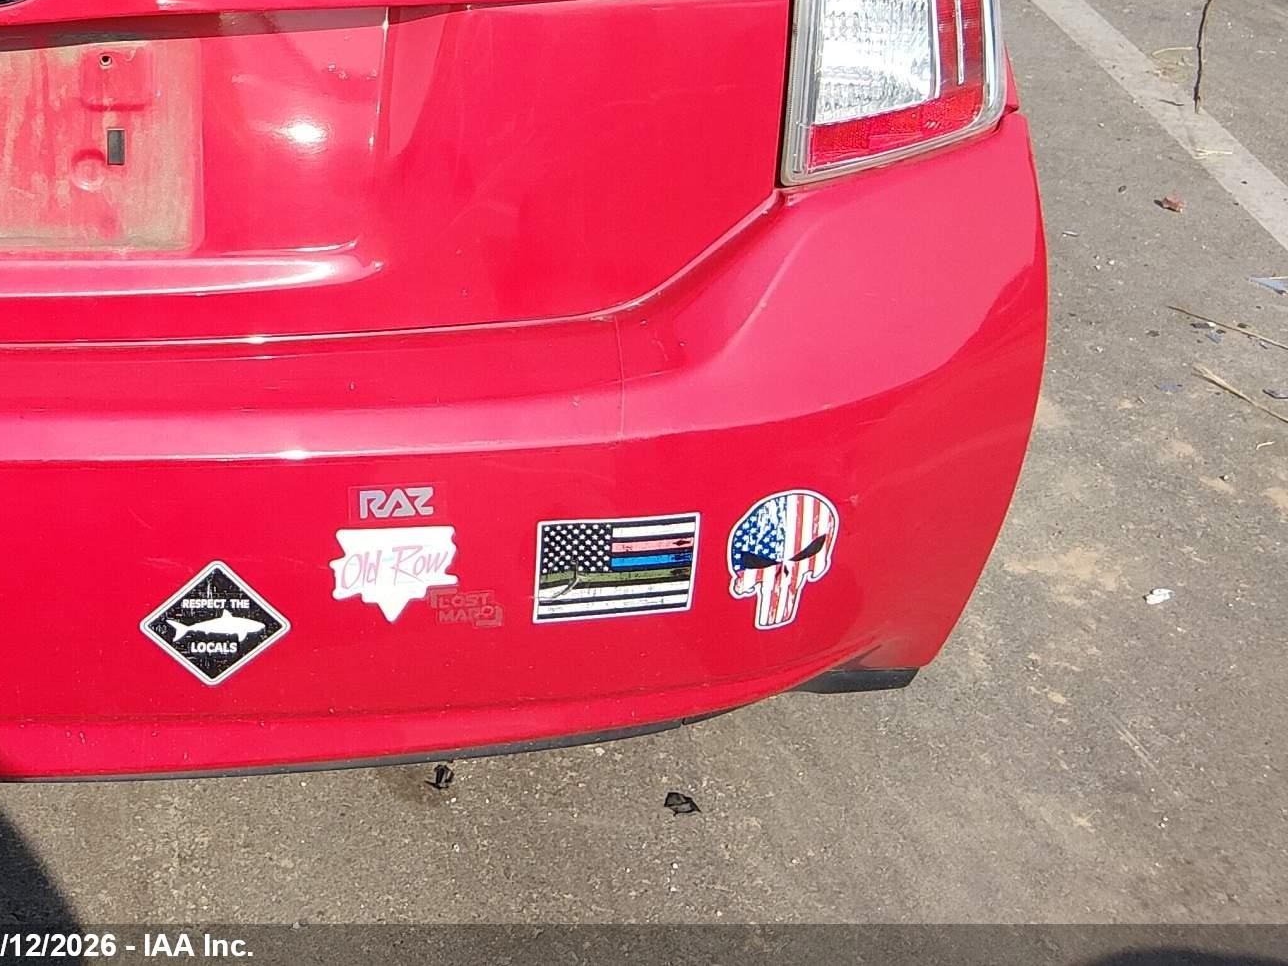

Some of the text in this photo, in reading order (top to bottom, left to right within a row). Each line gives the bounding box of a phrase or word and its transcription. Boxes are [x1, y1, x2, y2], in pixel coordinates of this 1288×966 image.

[359, 486, 434, 519] RAZ
[341, 545, 449, 589] Old Row
[182, 599, 250, 608] RESPECT THE
[191, 642, 237, 653] LOCALS
